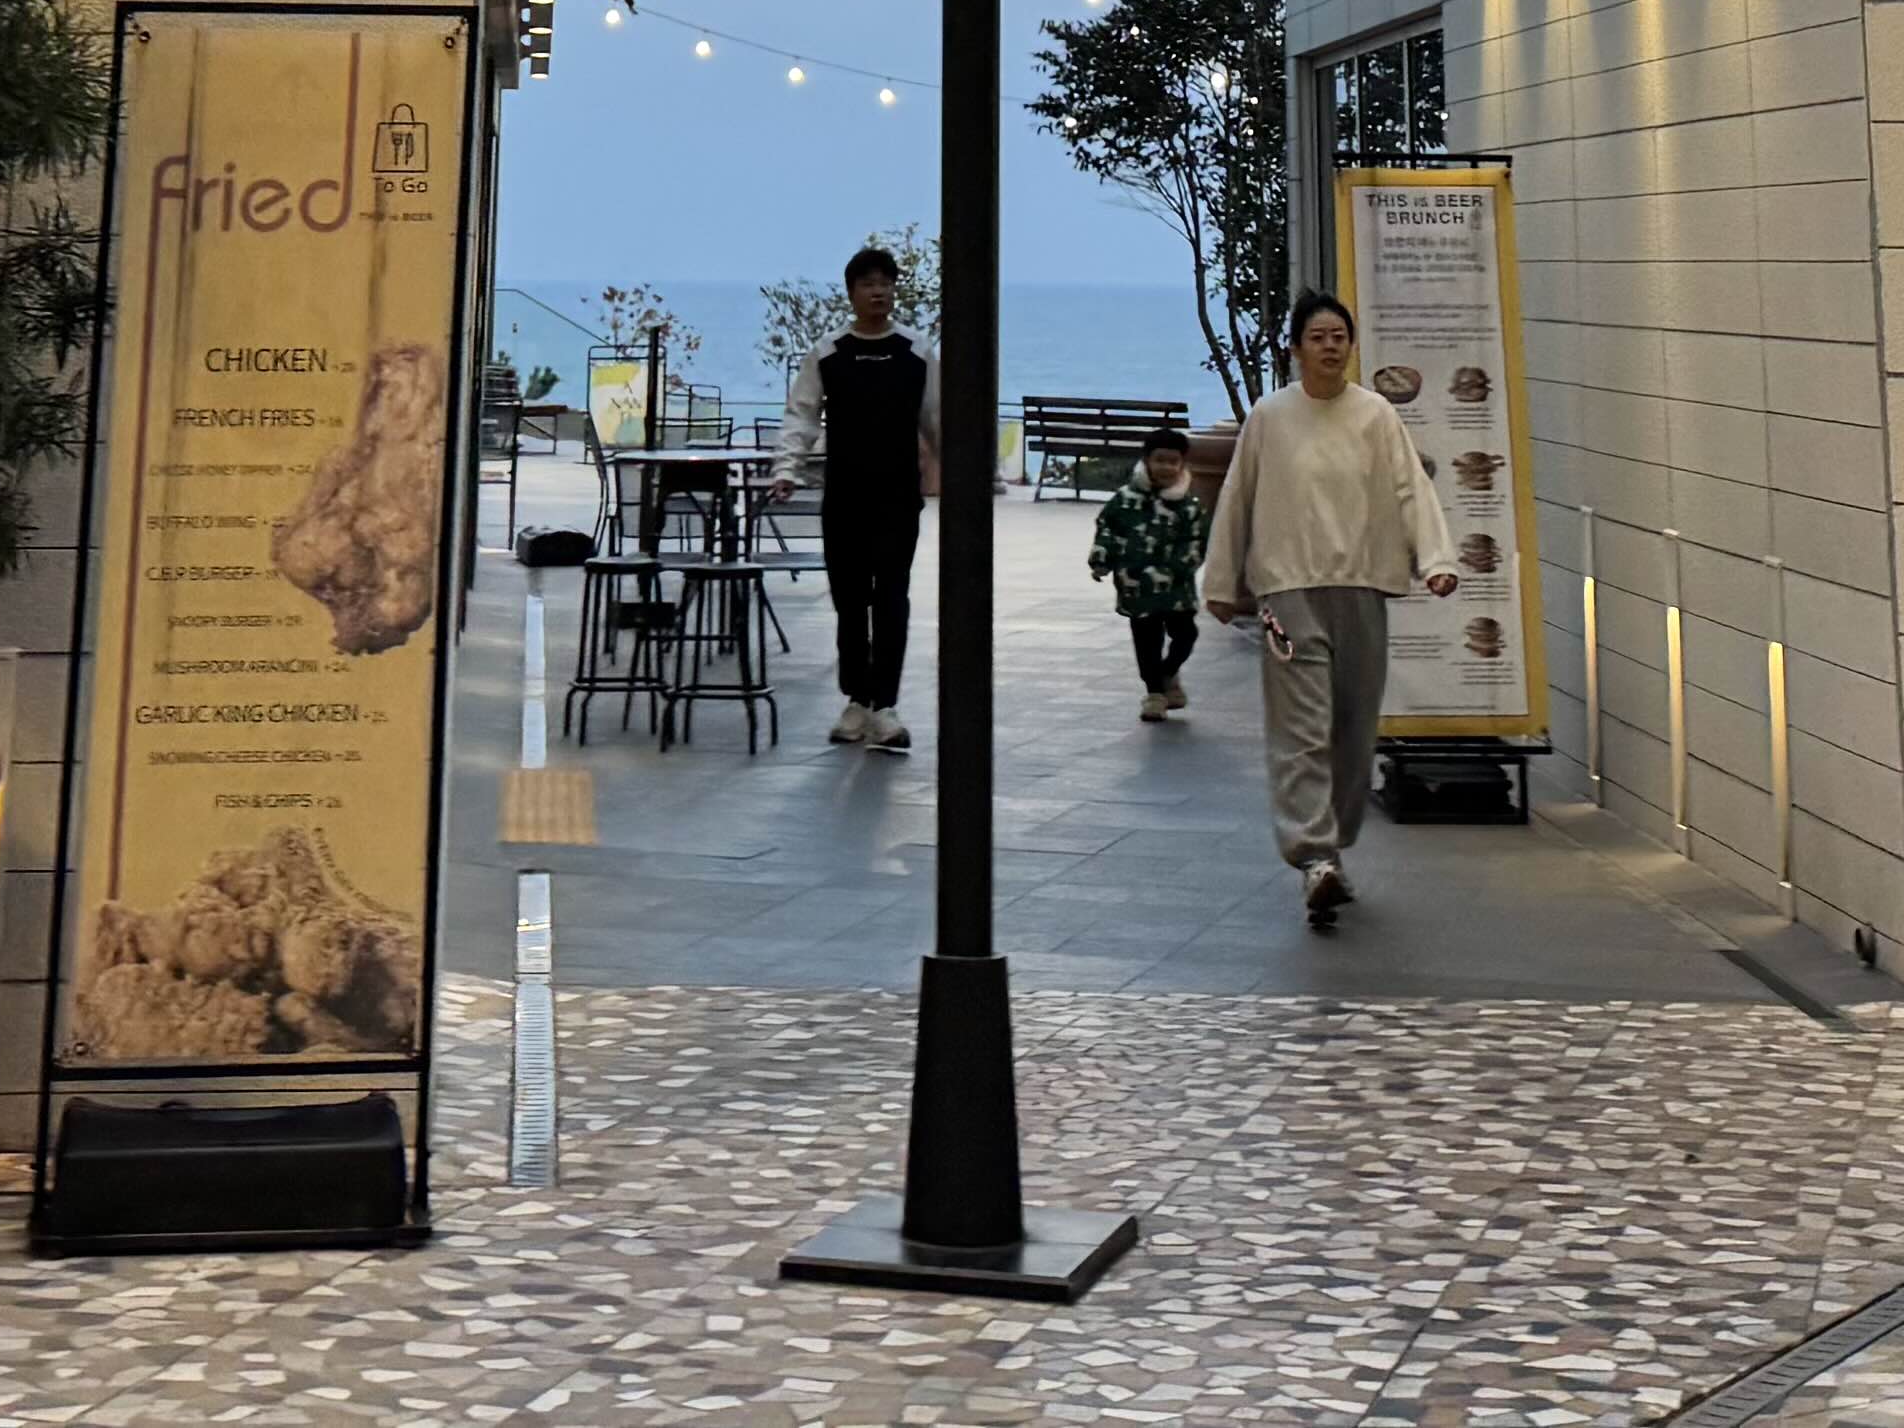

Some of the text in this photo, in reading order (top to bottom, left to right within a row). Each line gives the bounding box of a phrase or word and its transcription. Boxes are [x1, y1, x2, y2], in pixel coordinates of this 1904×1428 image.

[402, 177, 428, 192] Go
[1367, 194, 1408, 208] THIS
[1435, 194, 1483, 208] BEER
[1387, 212, 1464, 225] BRUNCH
[205, 348, 327, 372] CHICKEN
[175, 408, 254, 427] FRENCH
[260, 408, 315, 427] FRIES
[136, 705, 210, 724] GARLIC
[213, 705, 264, 722] KING
[268, 704, 358, 723] CHICKEN
[264, 794, 312, 807] CHIPS
